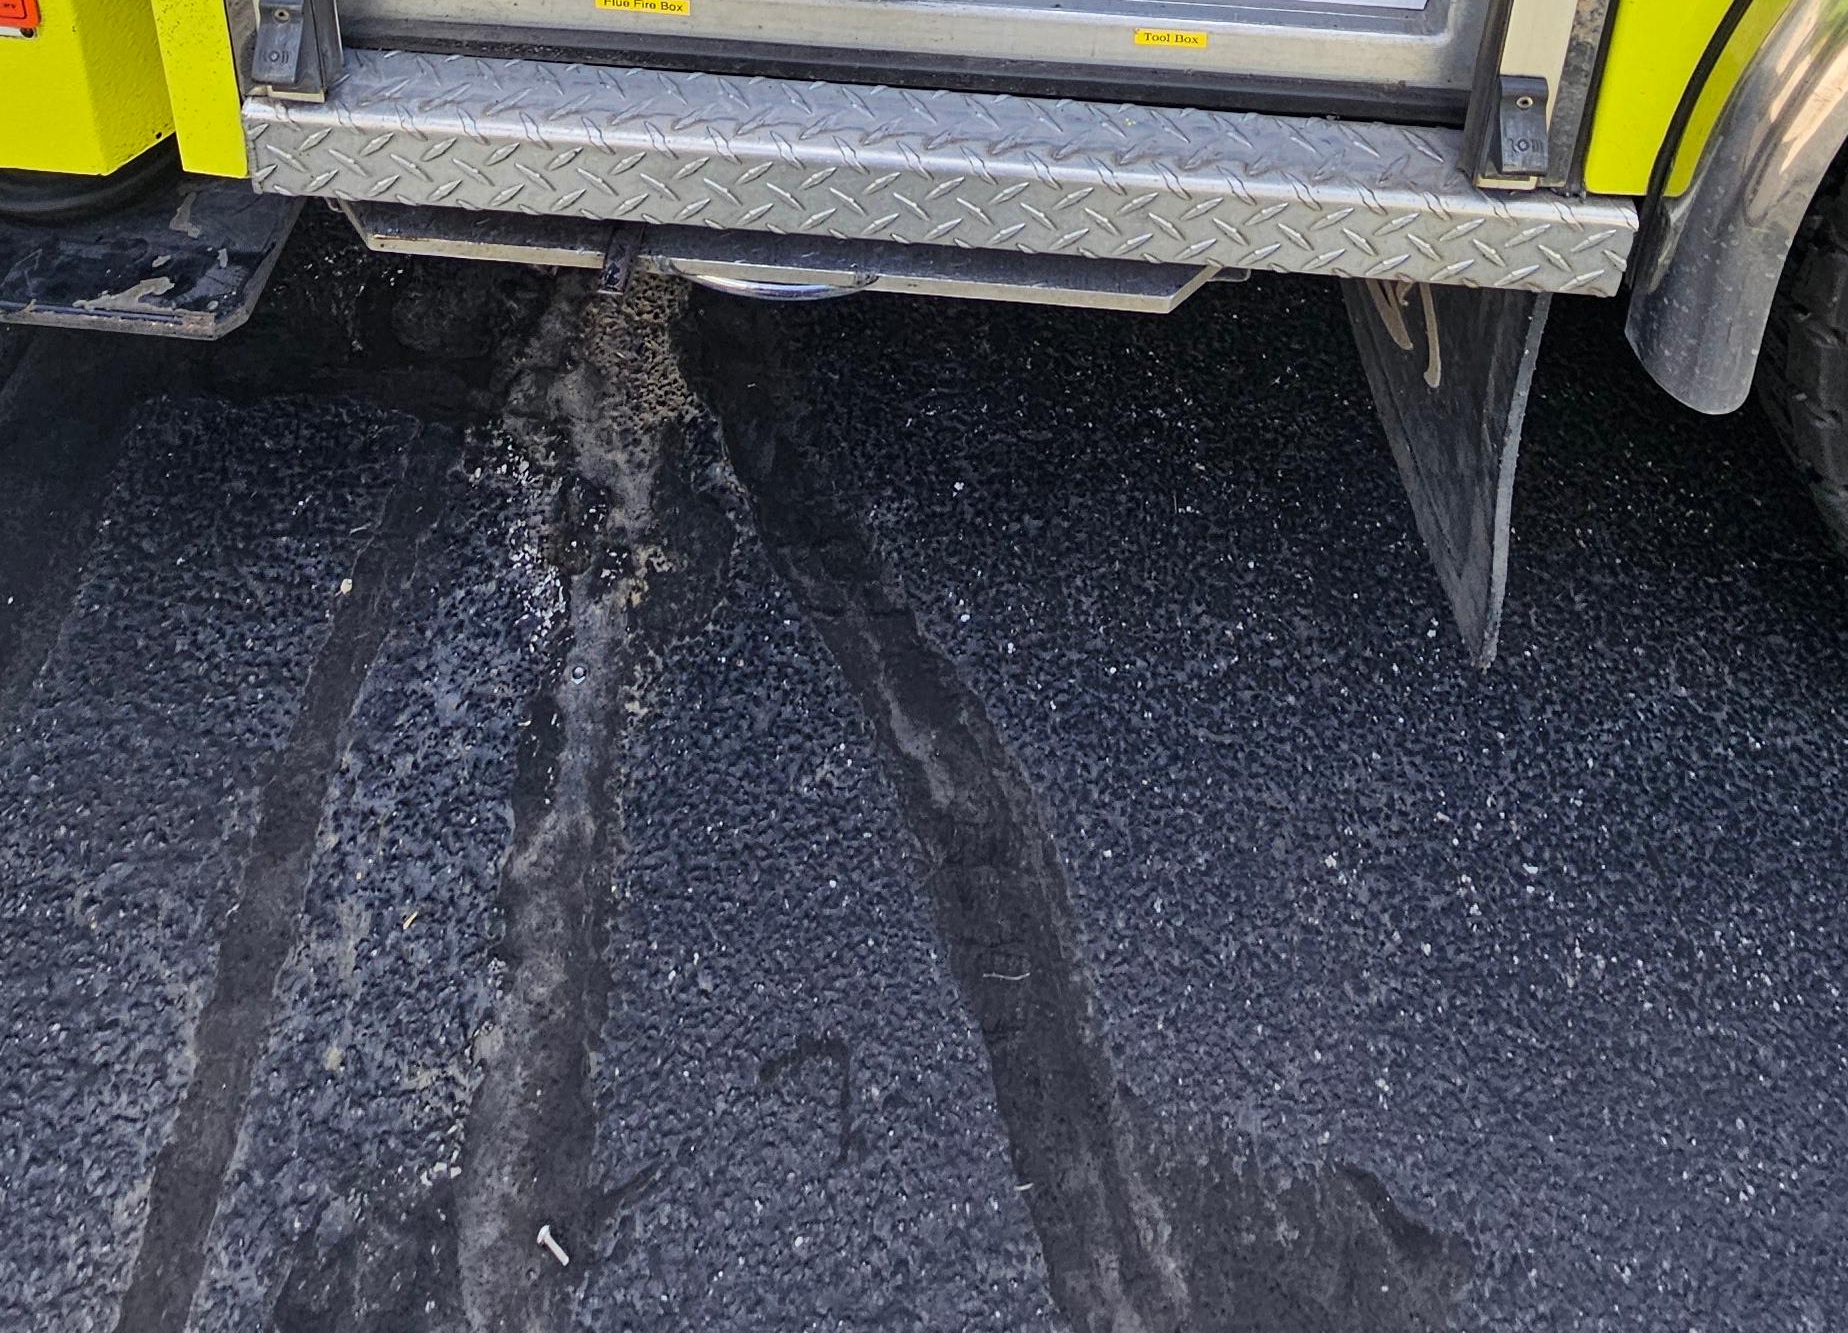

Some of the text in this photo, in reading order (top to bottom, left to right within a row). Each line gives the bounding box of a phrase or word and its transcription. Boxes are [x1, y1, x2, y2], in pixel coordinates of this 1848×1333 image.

[633, 0, 657, 10] Fire
[661, 1, 684, 12] Box
[1144, 32, 1200, 44] Tool Box
